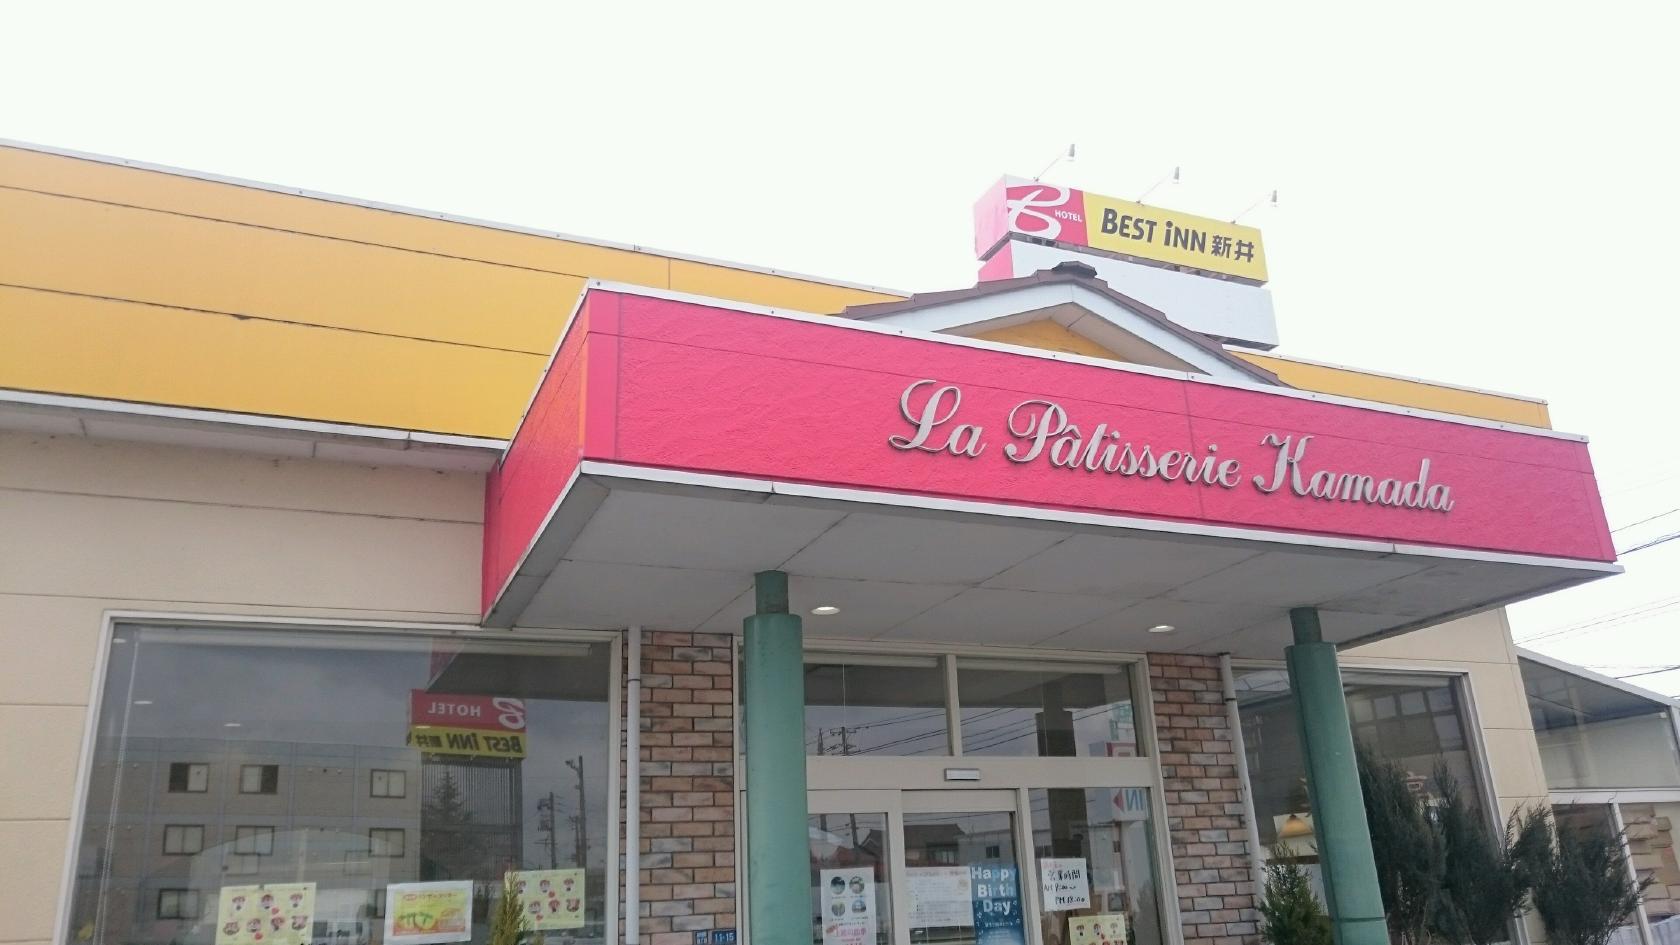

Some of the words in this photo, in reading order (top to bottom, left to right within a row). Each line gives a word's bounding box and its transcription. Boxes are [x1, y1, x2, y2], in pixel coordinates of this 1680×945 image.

[1054, 209, 1083, 223] HOTEL
[1101, 207, 1158, 244] BEST
[1211, 234, 1255, 263] 新井
[888, 378, 986, 459] La
[1003, 399, 1242, 489] Pâtisserie
[1253, 433, 1455, 513] Kamada
[971, 866, 1017, 882] Happy
[978, 882, 1017, 899] Birth
[983, 899, 1011, 916] Day
